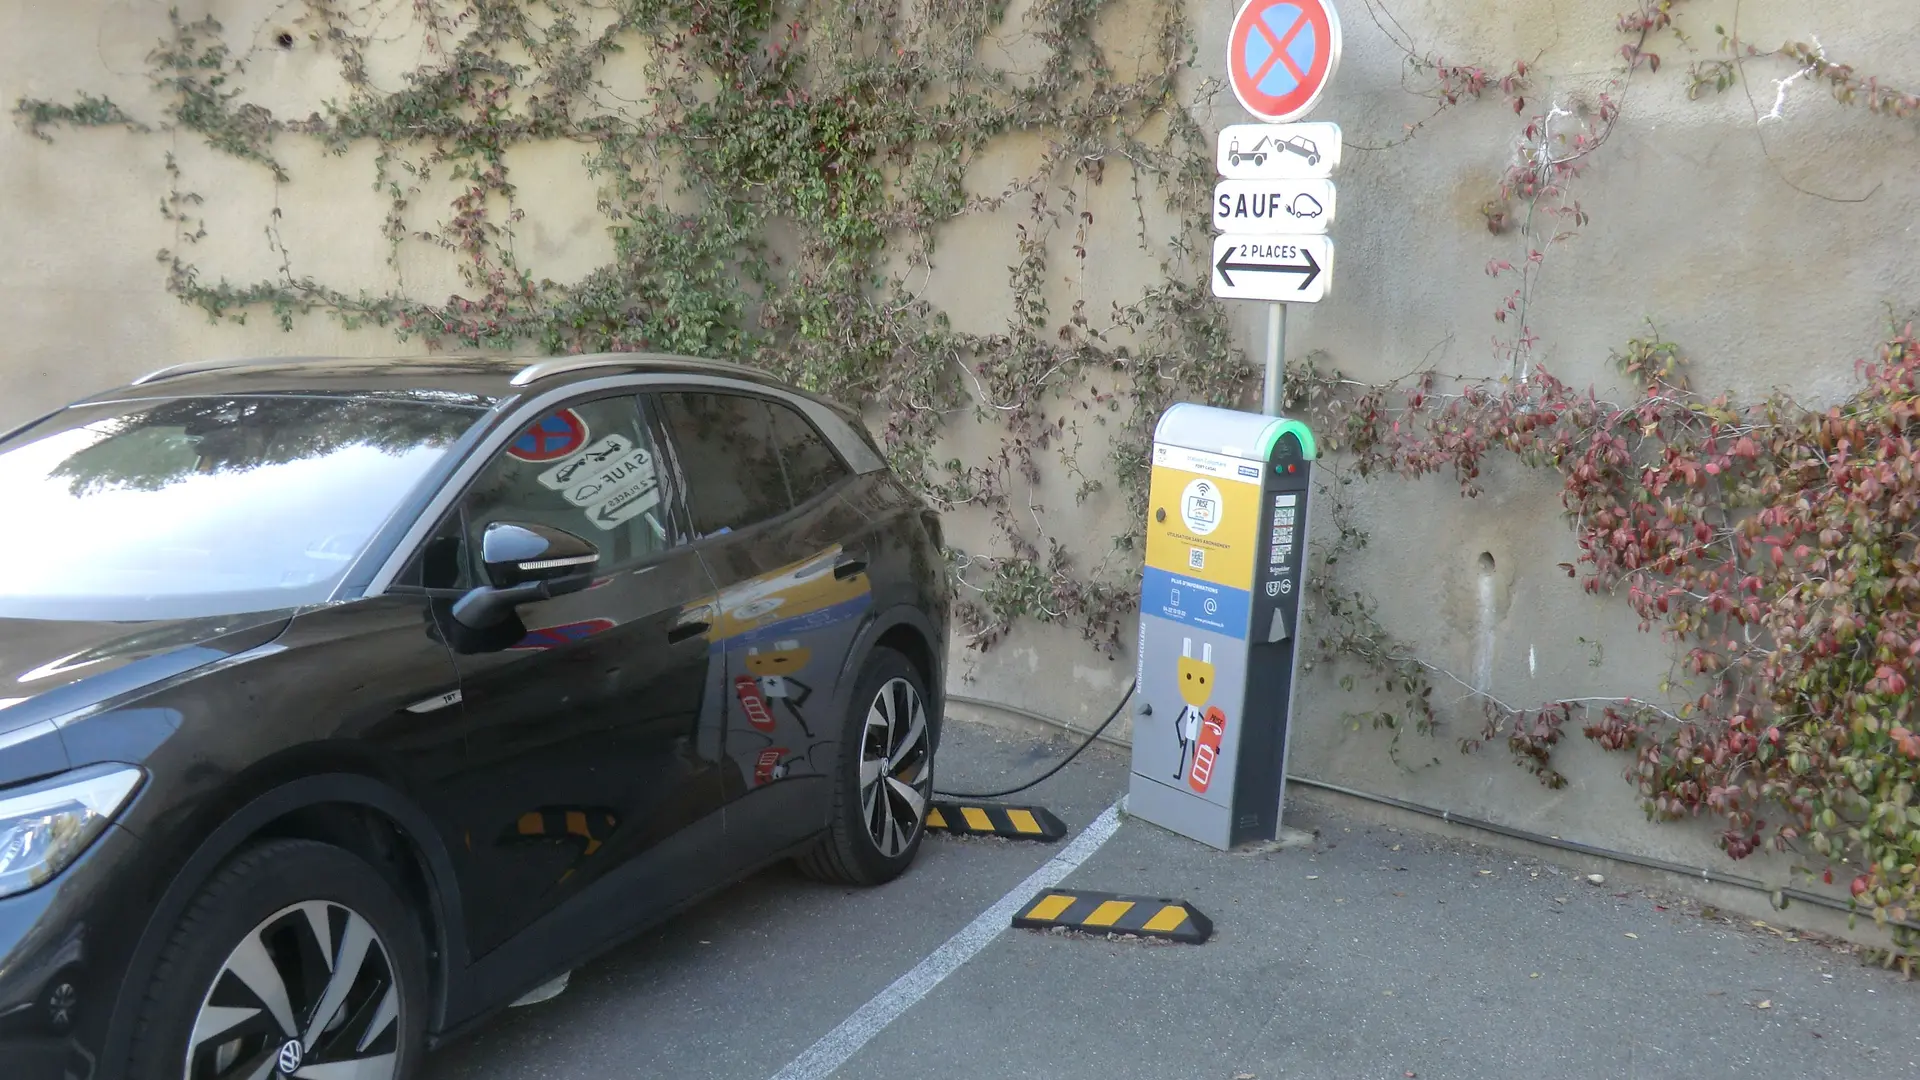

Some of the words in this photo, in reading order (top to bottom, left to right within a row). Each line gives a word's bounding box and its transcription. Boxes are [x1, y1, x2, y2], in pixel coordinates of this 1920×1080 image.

[1218, 193, 1281, 219] SAUF
[1240, 244, 1247, 257] 2
[1251, 244, 1297, 259] PLACES
[1166, 532, 1192, 540] UTILISATION
[1203, 539, 1230, 549] ABONNEMENT
